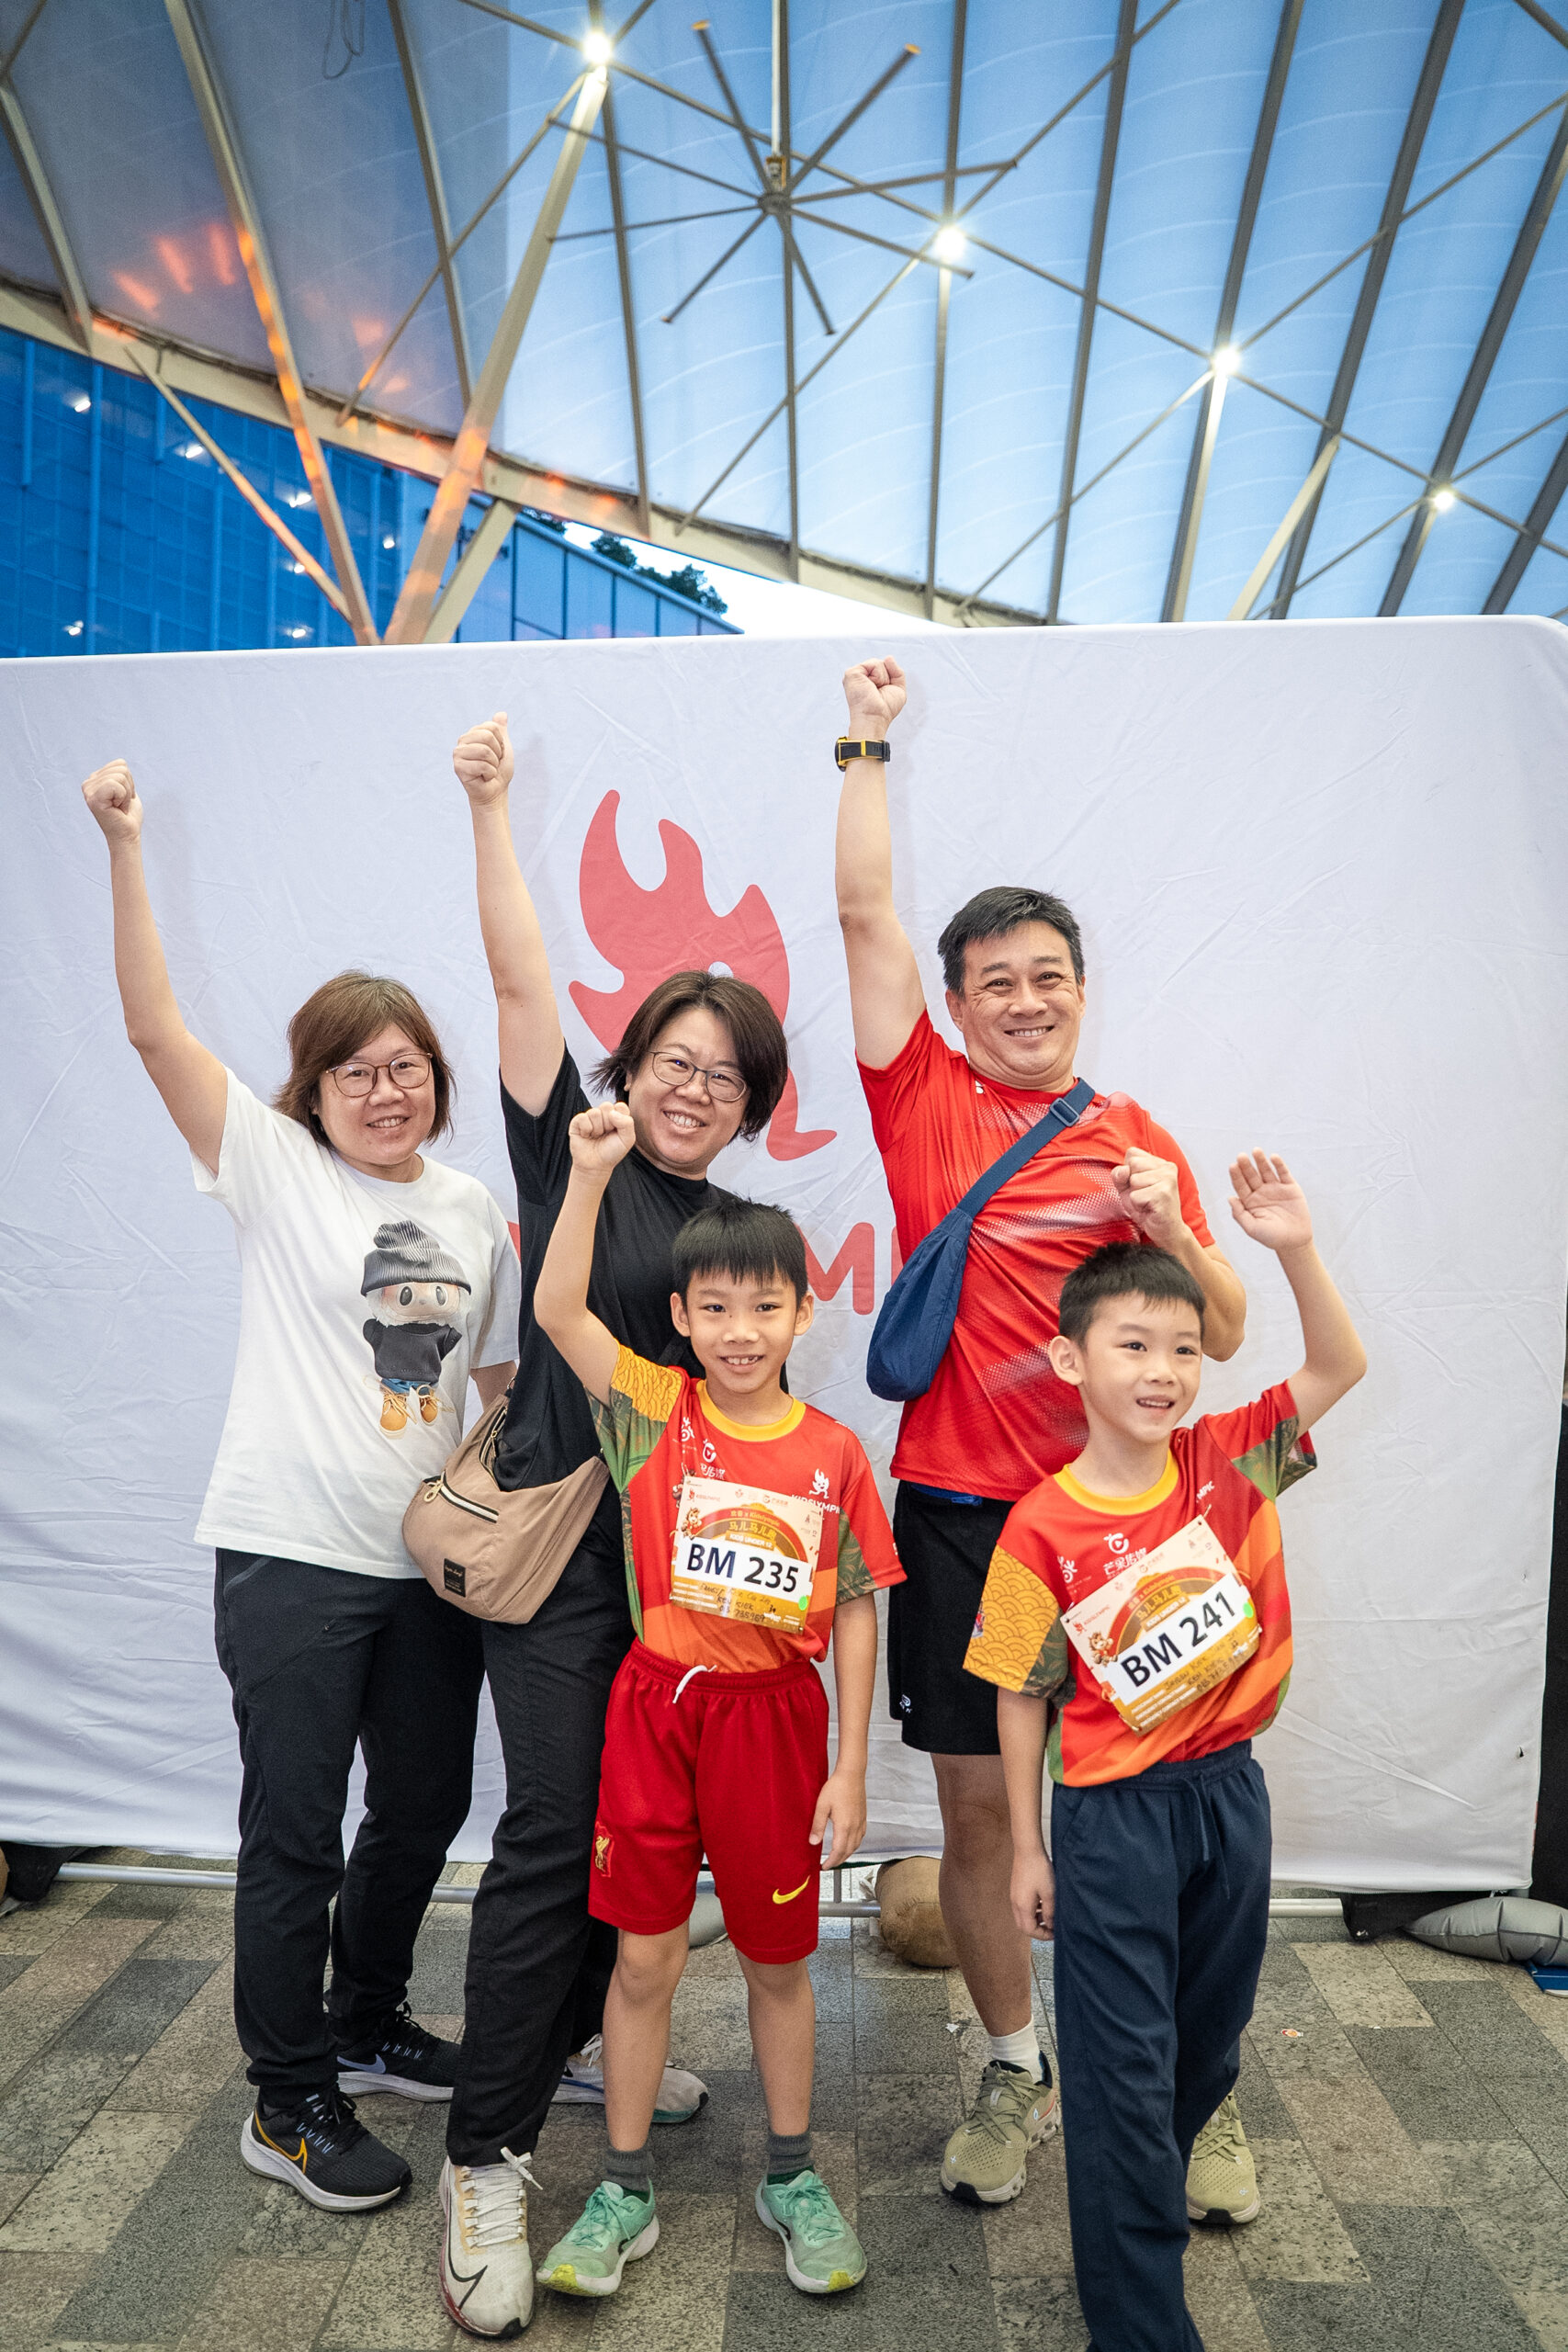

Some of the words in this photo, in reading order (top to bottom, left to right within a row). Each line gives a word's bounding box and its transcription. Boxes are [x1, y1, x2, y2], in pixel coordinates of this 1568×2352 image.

[686, 1544, 737, 1578] BM
[744, 1556, 799, 1593] 235
[1121, 1632, 1183, 1687] BM
[1179, 1591, 1235, 1647] 241
